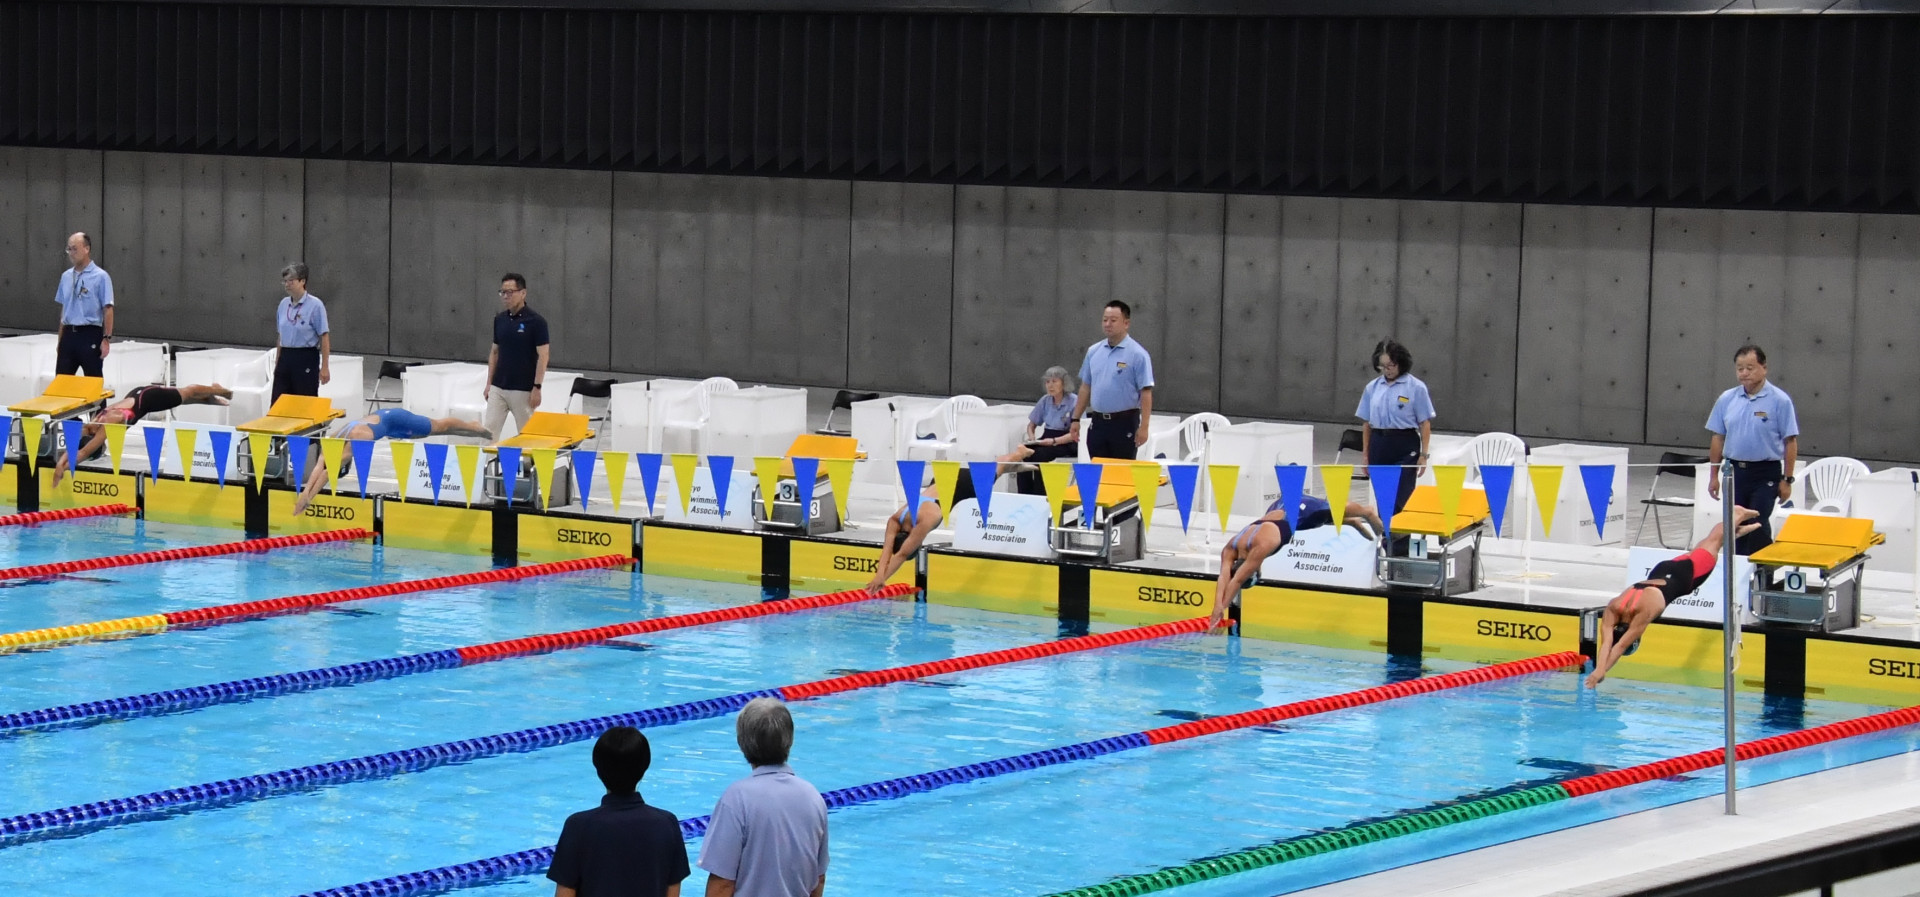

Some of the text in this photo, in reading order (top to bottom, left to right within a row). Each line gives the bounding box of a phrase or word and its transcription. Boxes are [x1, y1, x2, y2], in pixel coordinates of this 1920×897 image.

[58, 434, 66, 448] 6
[415, 458, 429, 469] Toky
[73, 480, 119, 497] SEIKO
[782, 484, 792, 500] 3
[690, 494, 720, 507] wimming
[305, 503, 355, 520] SEIKO
[810, 501, 819, 517] 3
[971, 507, 993, 518] Too
[557, 528, 612, 546] SEIKO
[982, 531, 1027, 544] Association
[1110, 528, 1119, 544] 2
[1290, 535, 1306, 548] kyo
[1287, 548, 1331, 563] Swimming
[1413, 540, 1421, 557] 1
[833, 555, 880, 574] SEIK
[1294, 560, 1344, 573] Association
[1446, 561, 1453, 577] 1
[1787, 573, 1803, 591] 0
[1138, 586, 1204, 607] SEIKO
[1670, 596, 1715, 608] sociation
[1477, 619, 1552, 642] SEIKO
[1869, 657, 1920, 679] SEI
